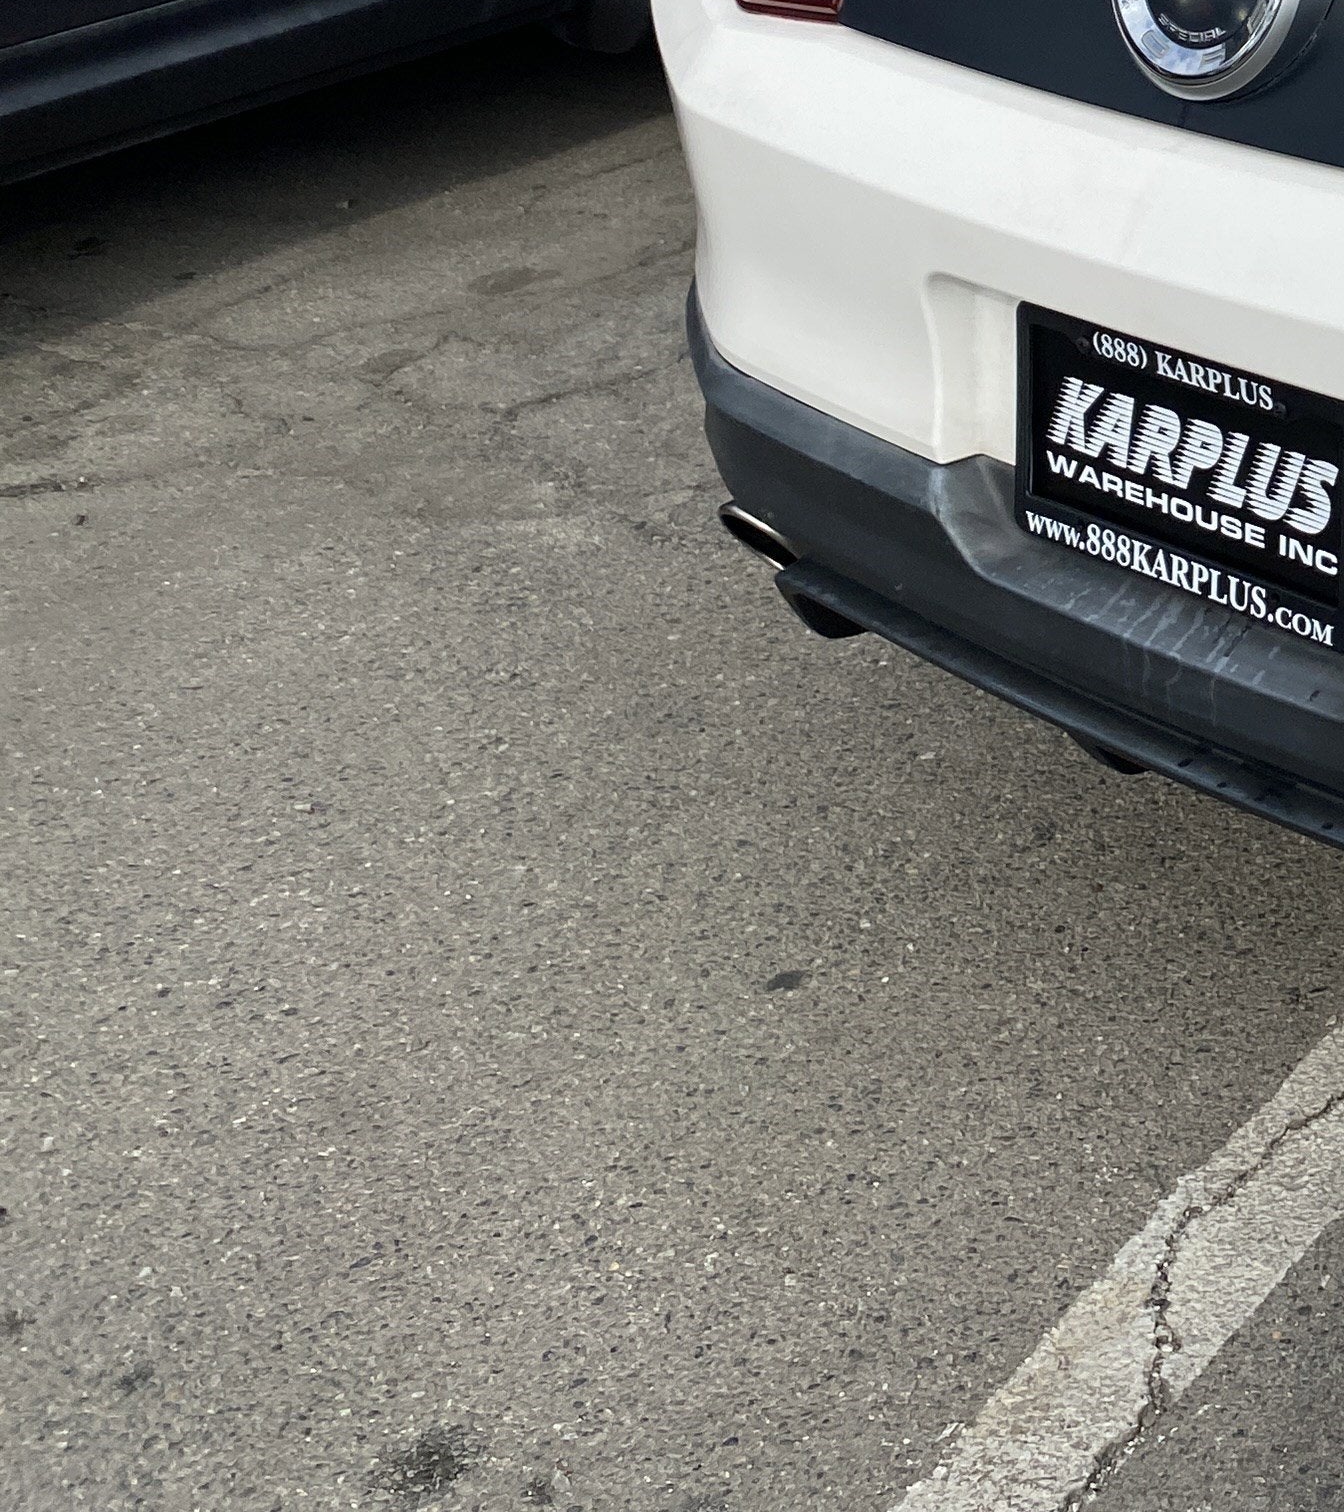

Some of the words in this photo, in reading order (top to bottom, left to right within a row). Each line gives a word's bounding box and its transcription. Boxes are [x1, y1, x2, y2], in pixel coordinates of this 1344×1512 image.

[1157, 12, 1227, 43] SPECIAL
[1092, 331, 1148, 369] (888)
[1155, 350, 1274, 411] KARPLUS
[1046, 376, 1340, 535] KARPLUS
[1046, 450, 1266, 549] WAREHOUSE
[1278, 534, 1339, 576] INC
